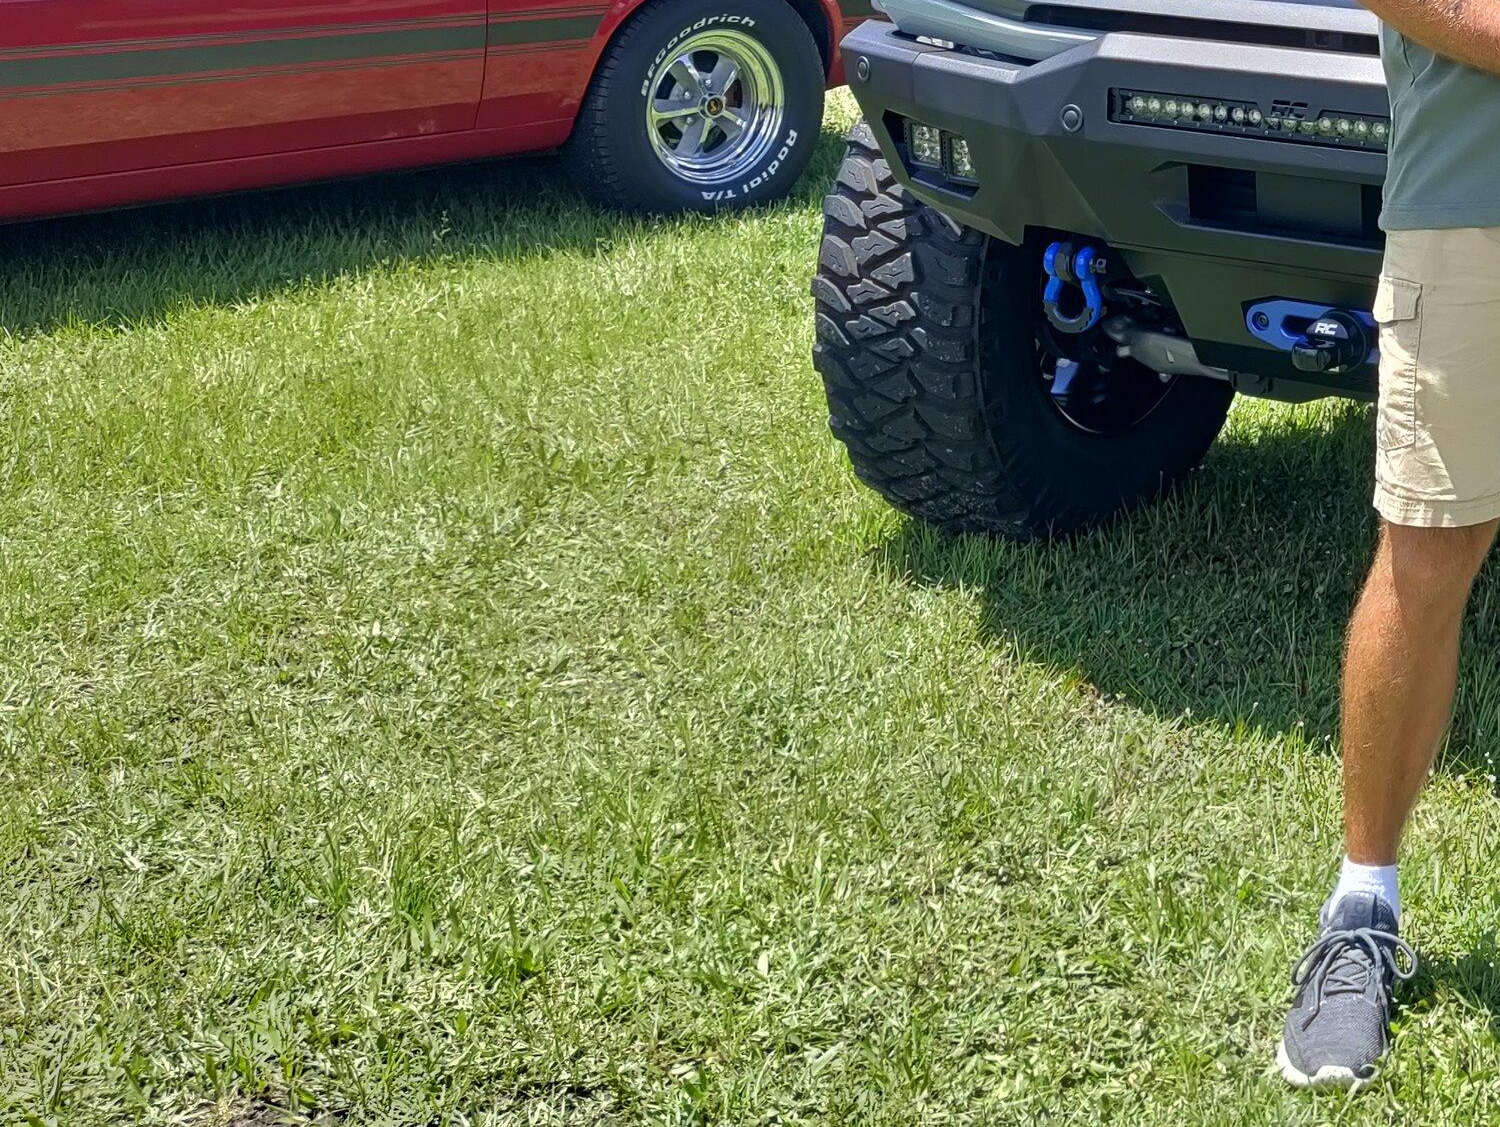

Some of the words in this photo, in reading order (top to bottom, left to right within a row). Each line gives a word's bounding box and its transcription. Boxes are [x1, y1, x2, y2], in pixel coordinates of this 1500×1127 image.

[640, 13, 756, 97] BFGoodrich
[741, 128, 798, 195] Radial
[701, 190, 737, 202] T/A
[1314, 322, 1339, 336] RC
